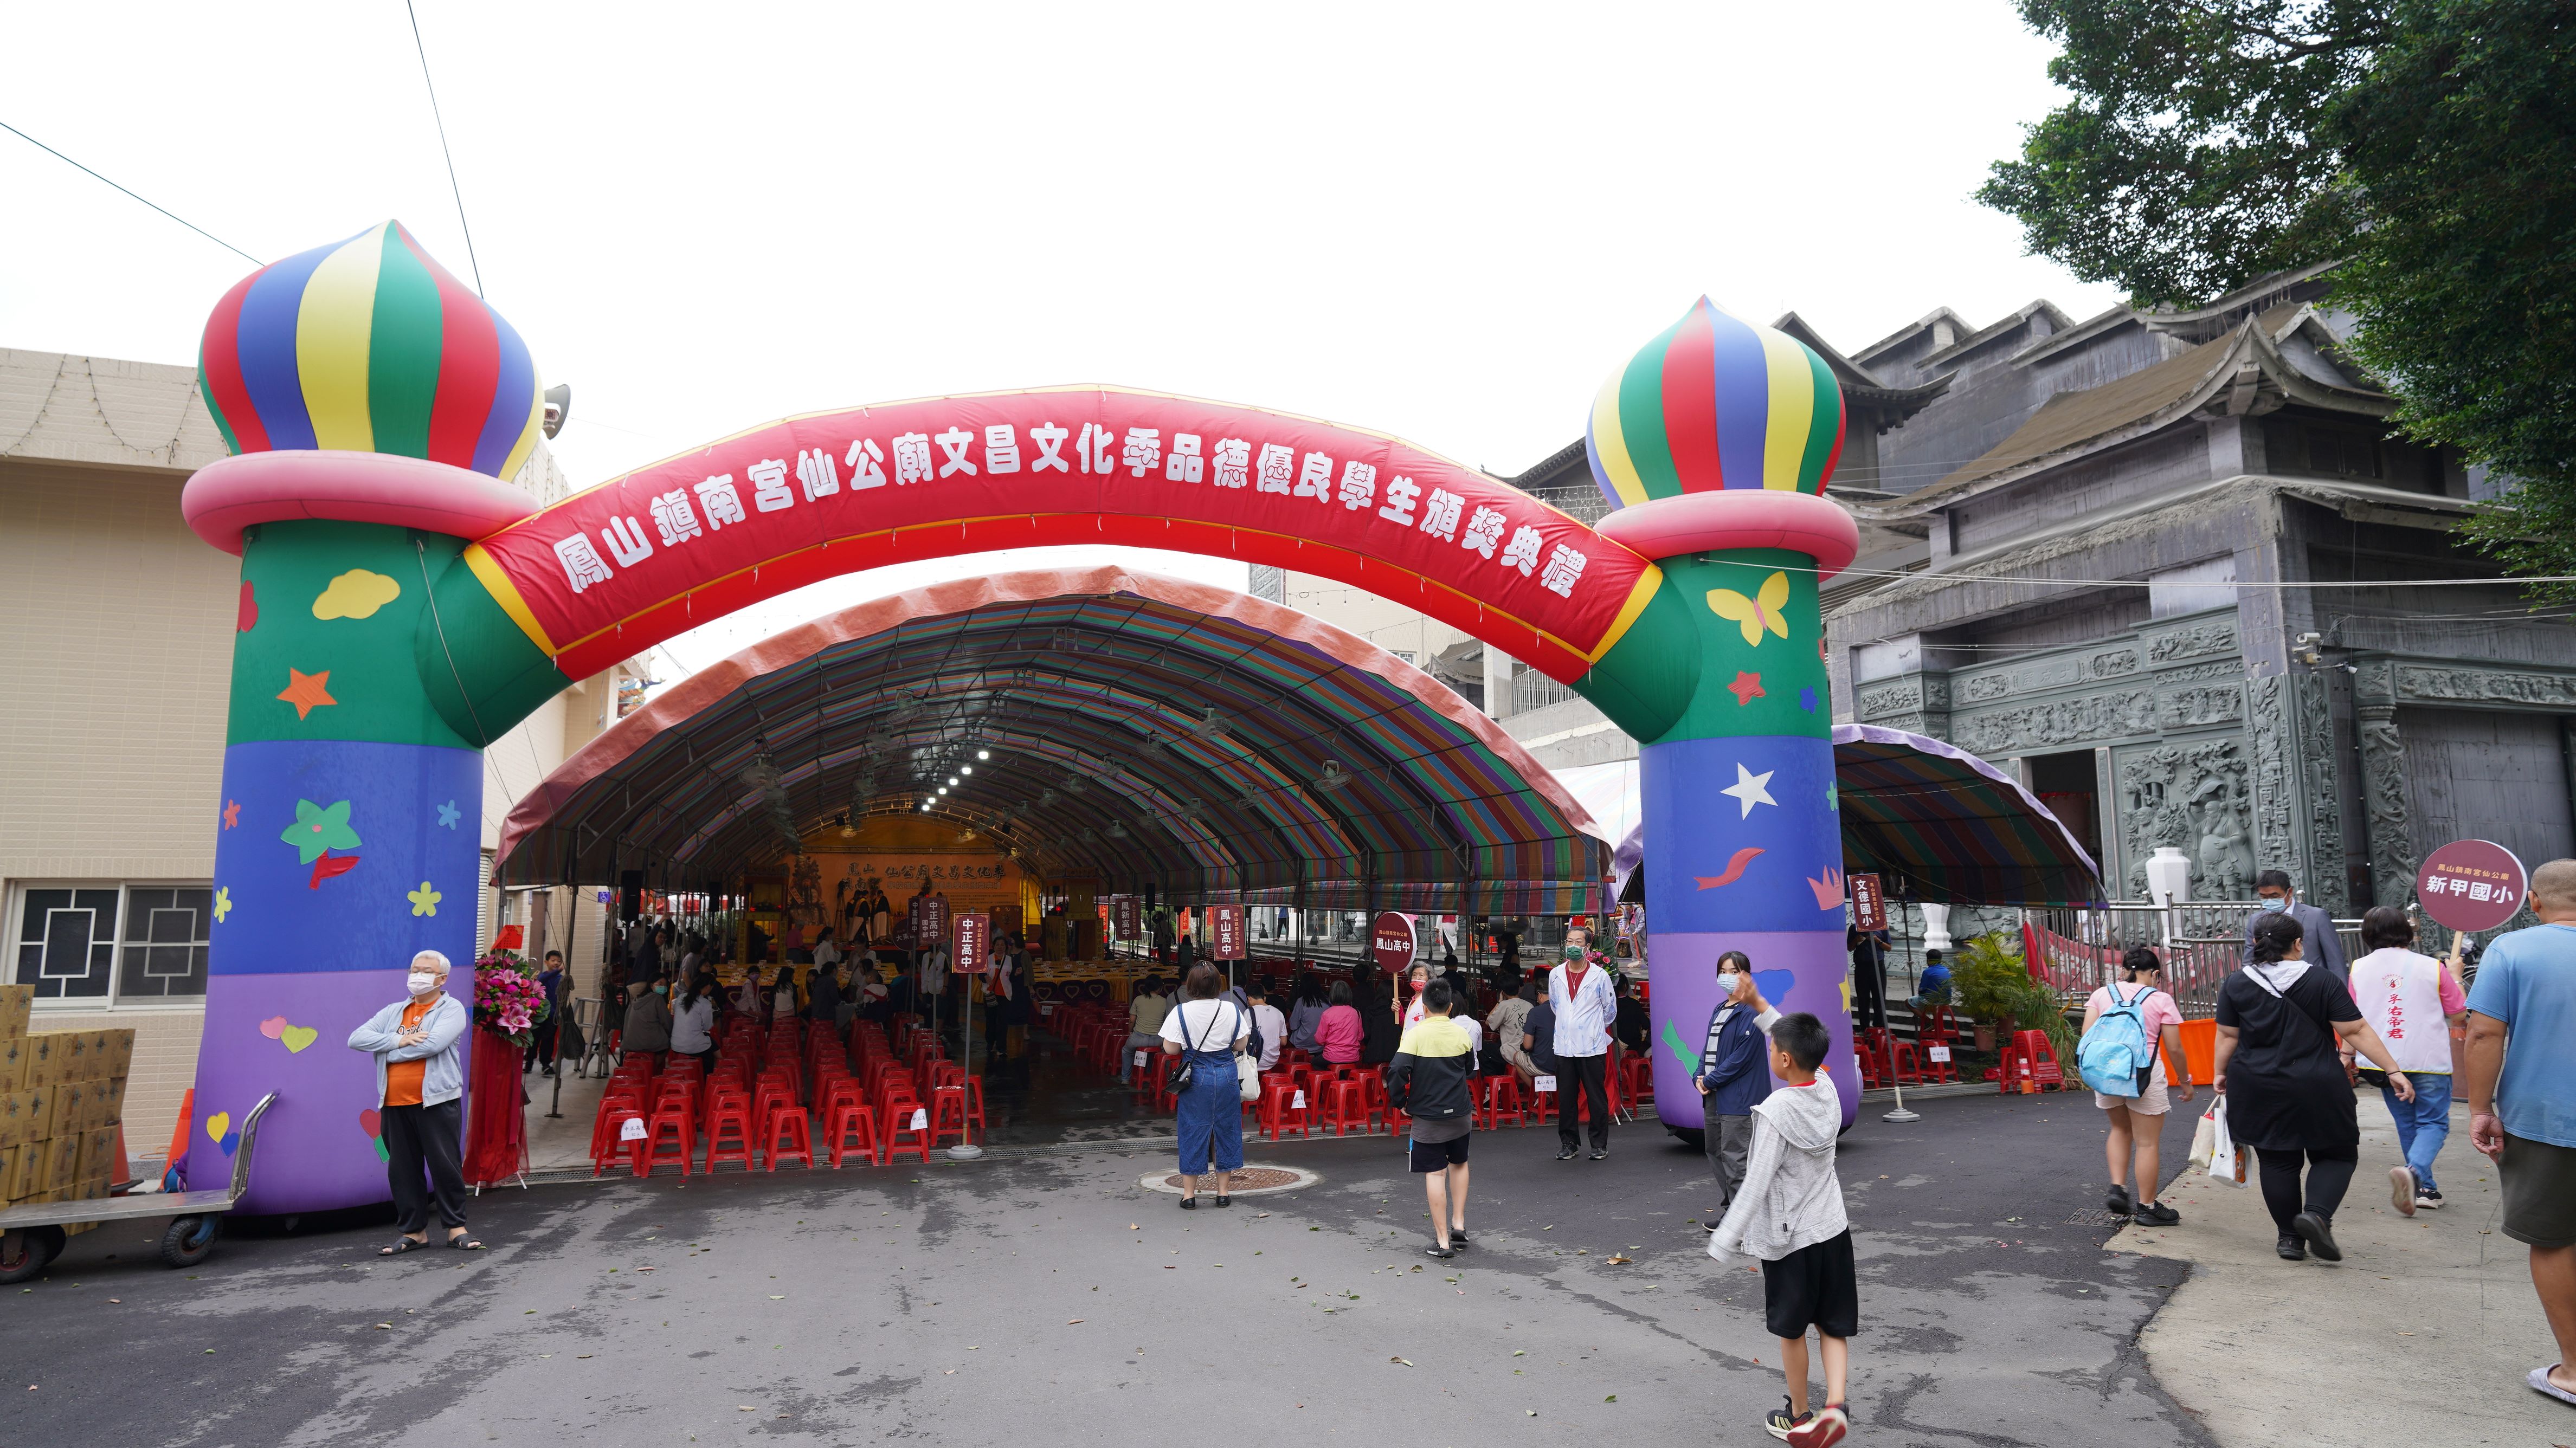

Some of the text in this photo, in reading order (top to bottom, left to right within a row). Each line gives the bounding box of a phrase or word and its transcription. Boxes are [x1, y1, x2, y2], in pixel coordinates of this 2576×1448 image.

[553, 422, 1587, 598] 鳳山鎮南宮仙公廟文昌文化季品德優良學生頒獎典禮
[2425, 875, 2514, 904] 新甲國小
[2437, 864, 2509, 881] 鳳山鎮南宮仙公廟
[929, 901, 938, 939] 中正高中
[1121, 902, 1130, 937] 鳳新高中
[1856, 879, 1873, 927] 文德國小
[961, 919, 974, 968] 中正高中
[1220, 909, 1232, 955] 鳳山高中
[1376, 938, 1411, 953] 鳳山高中
[2386, 993, 2406, 1039] 孚佑帝君
